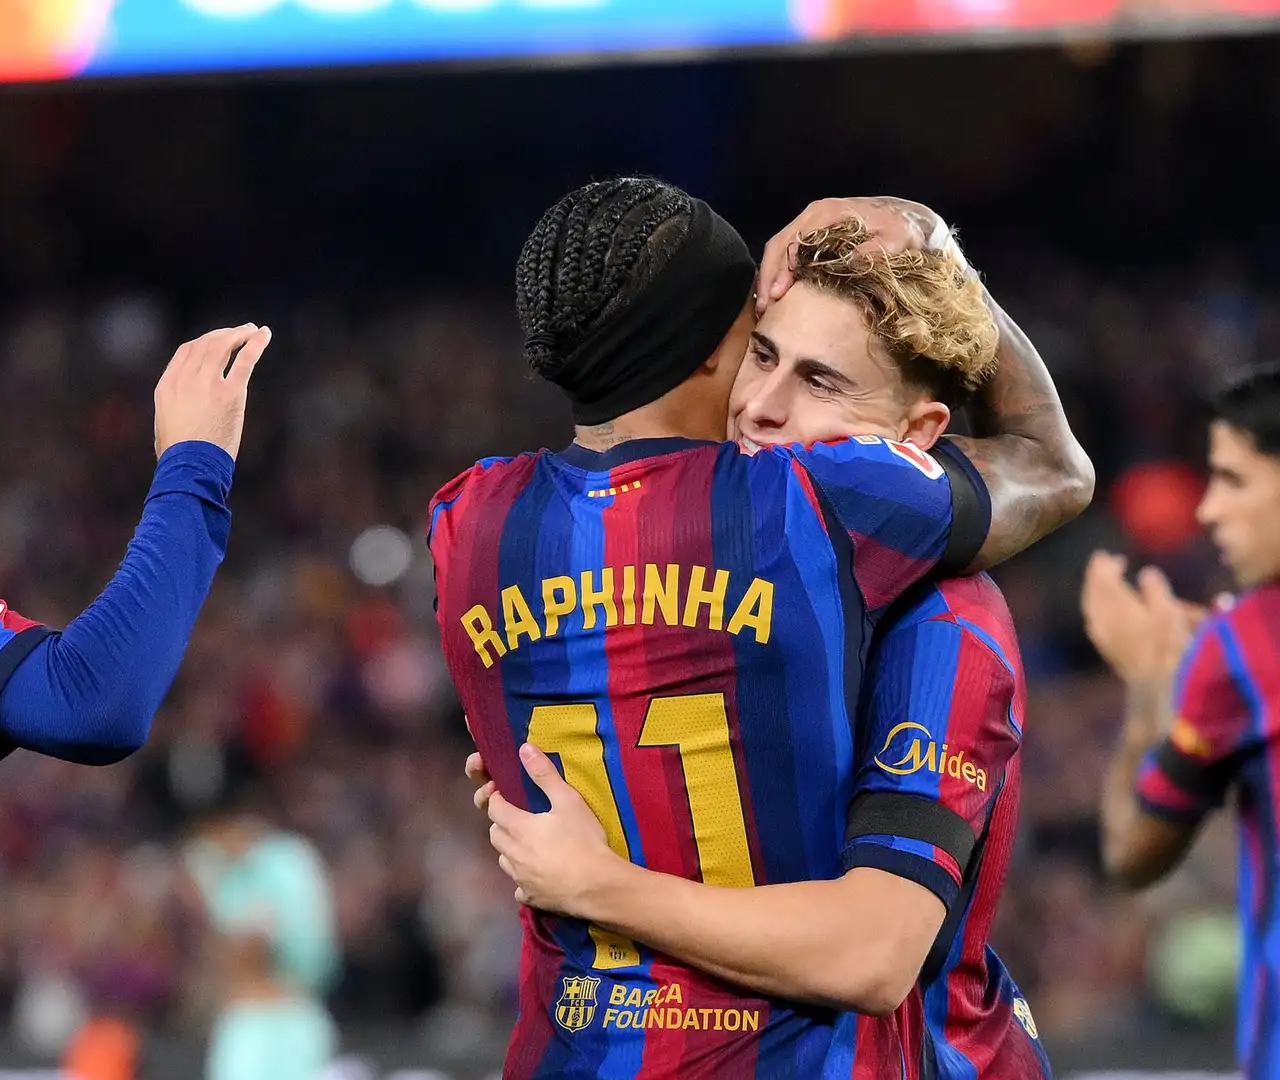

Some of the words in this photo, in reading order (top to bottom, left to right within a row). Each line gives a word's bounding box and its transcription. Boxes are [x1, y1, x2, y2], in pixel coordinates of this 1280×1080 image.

[460, 563, 775, 669] RAPHINHA
[873, 721, 987, 792] Midea
[524, 692, 756, 970] 11
[570, 999, 585, 1007] FCB
[602, 1008, 759, 1031] FOUNDATION
[608, 983, 683, 1008] BARÇA
